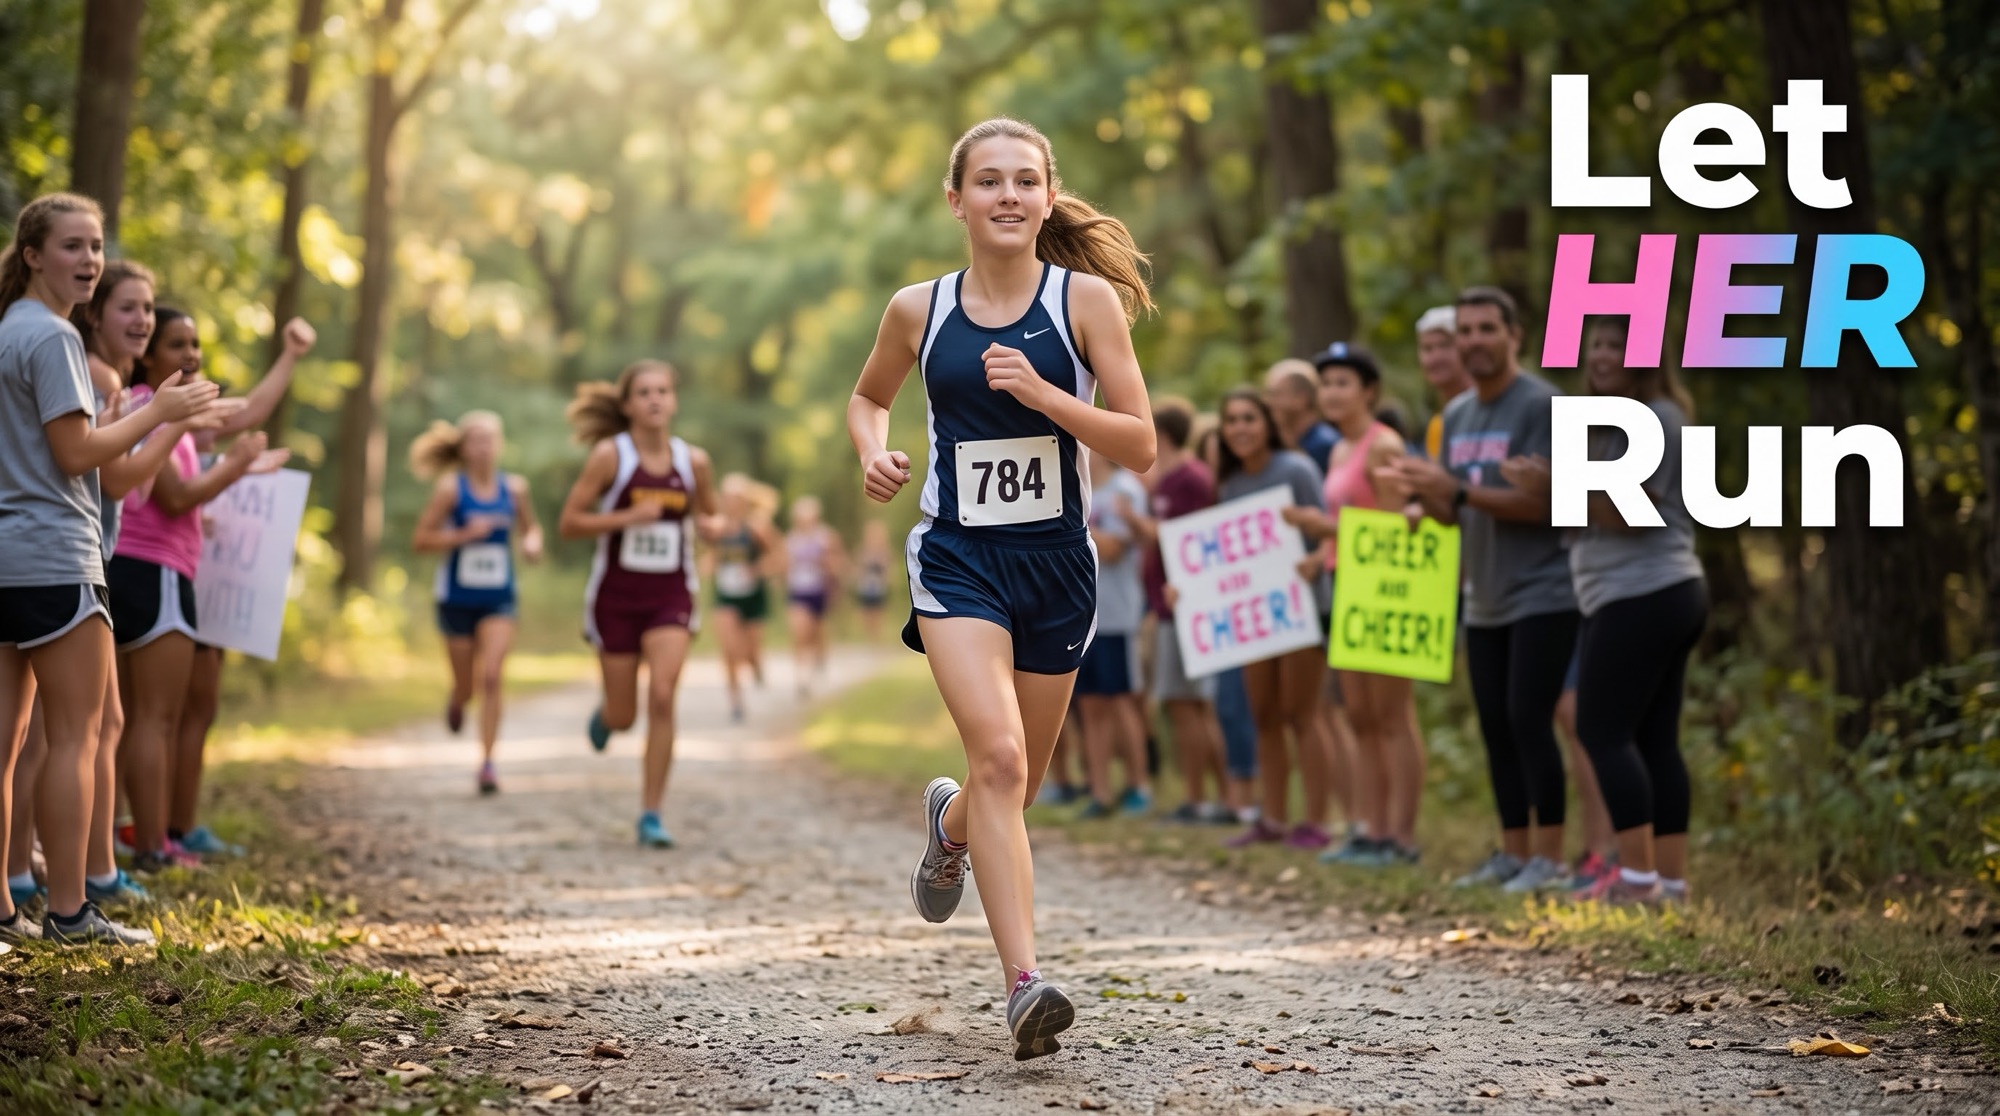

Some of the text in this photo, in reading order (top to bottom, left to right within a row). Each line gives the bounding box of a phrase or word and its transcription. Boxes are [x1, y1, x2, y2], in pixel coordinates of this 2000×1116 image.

[971, 457, 1045, 504] 784
[1179, 508, 1281, 575] CHEER
[1353, 525, 1439, 572] CHEER
[1191, 581, 1305, 655] CHEER!
[1343, 606, 1445, 662] CHEER!
